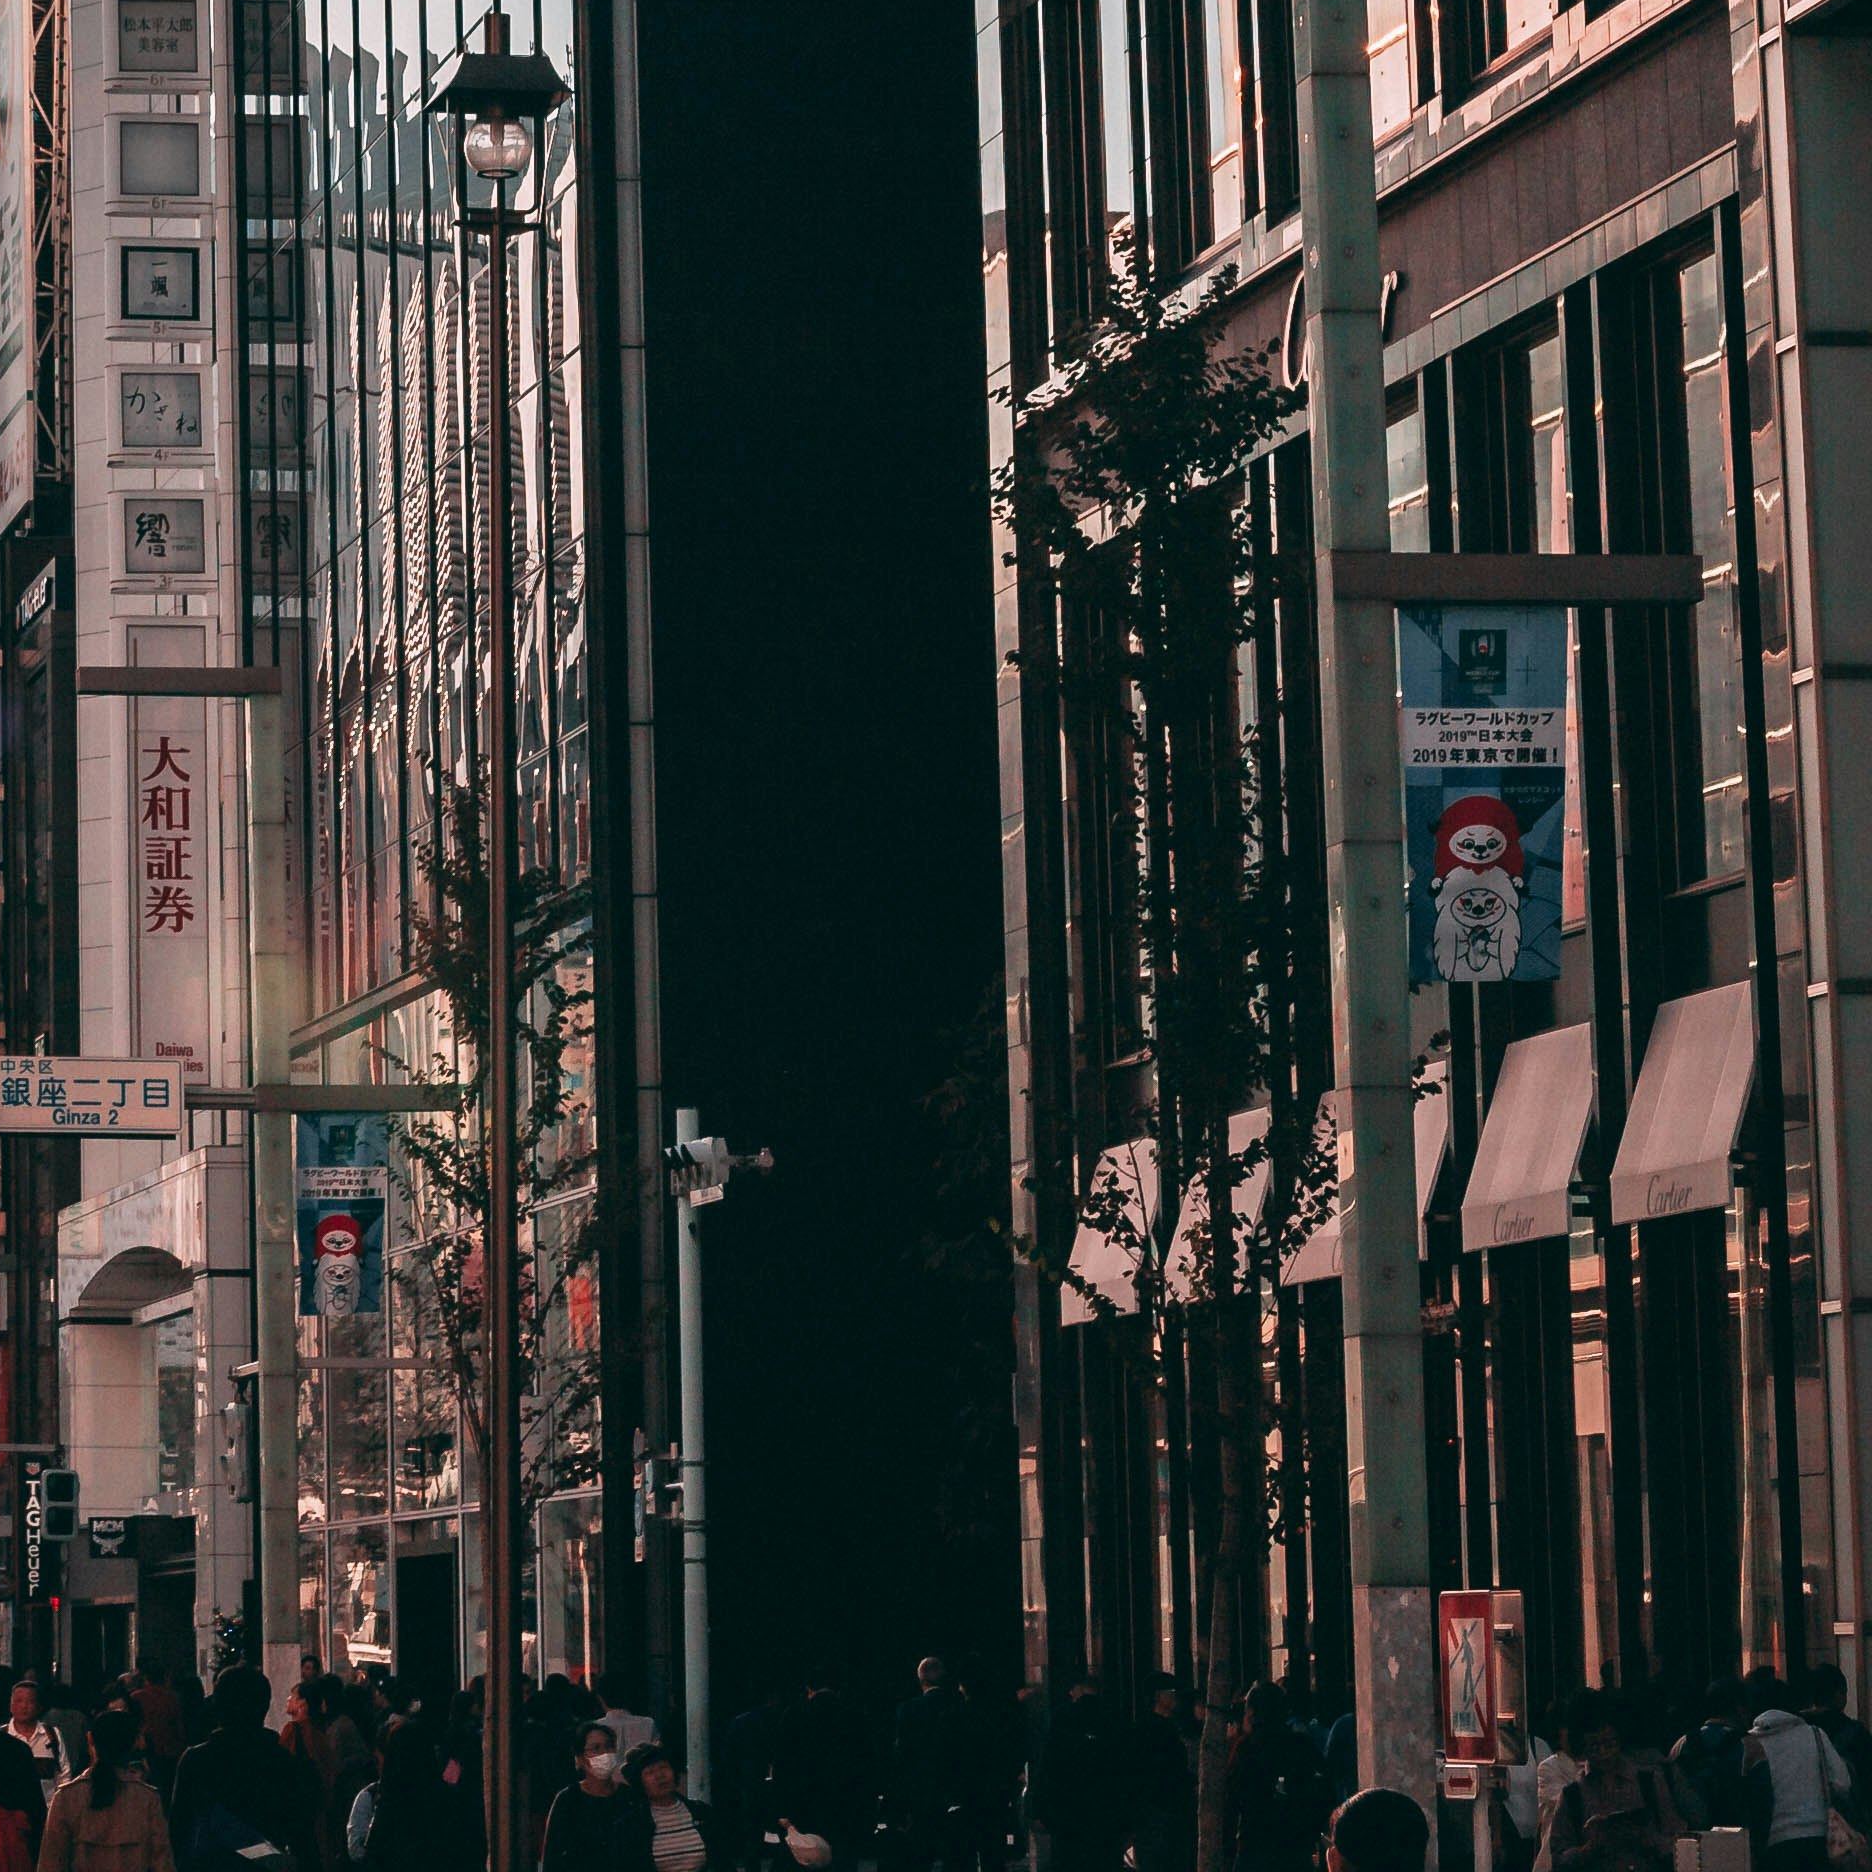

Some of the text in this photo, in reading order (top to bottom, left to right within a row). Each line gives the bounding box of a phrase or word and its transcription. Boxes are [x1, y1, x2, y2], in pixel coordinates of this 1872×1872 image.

[122, 16, 194, 35] 松本平太郎
[136, 36, 179, 55] 美容室
[1415, 711, 1556, 726] ラグビーワールドカップ
[1438, 728, 1534, 744] 2019™日本大会
[141, 736, 195, 934] 大和証券
[155, 1041, 194, 1058] Daiwa
[0, 1059, 55, 1076] 中央区
[0, 1077, 172, 1110] 銀座二丁目
[51, 1108, 120, 1128] Ginza 2
[1645, 1173, 1695, 1215] Cartier
[1492, 1209, 1536, 1243] Cartier
[92, 1519, 127, 1534] MCM
